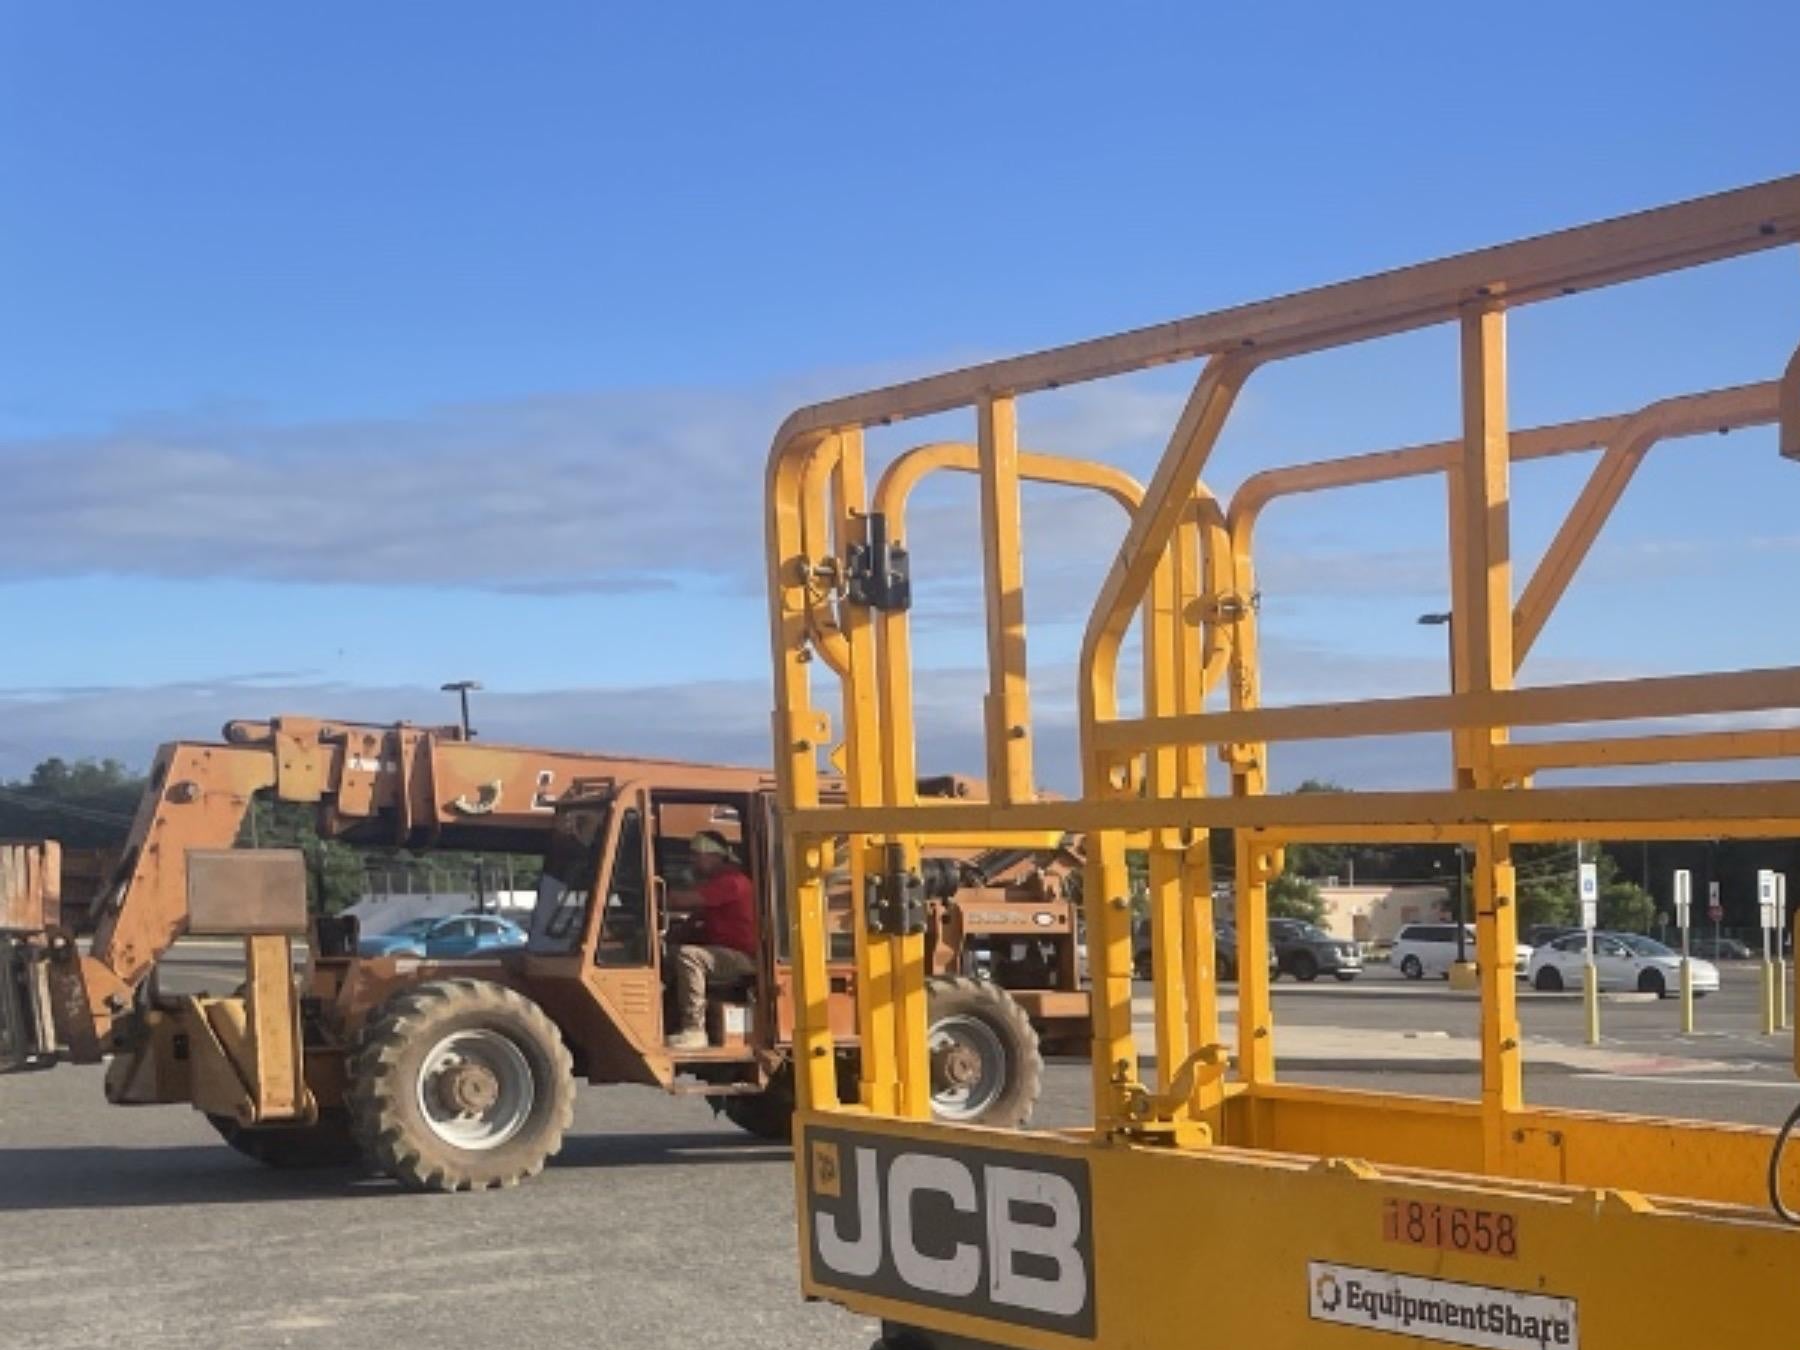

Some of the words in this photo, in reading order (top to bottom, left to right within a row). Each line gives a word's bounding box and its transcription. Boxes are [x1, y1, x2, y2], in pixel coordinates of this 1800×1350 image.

[815, 1146, 1088, 1316] JCB
[1384, 1199, 1517, 1256] 181658
[1346, 1280, 1570, 1345] EquipmentShare
